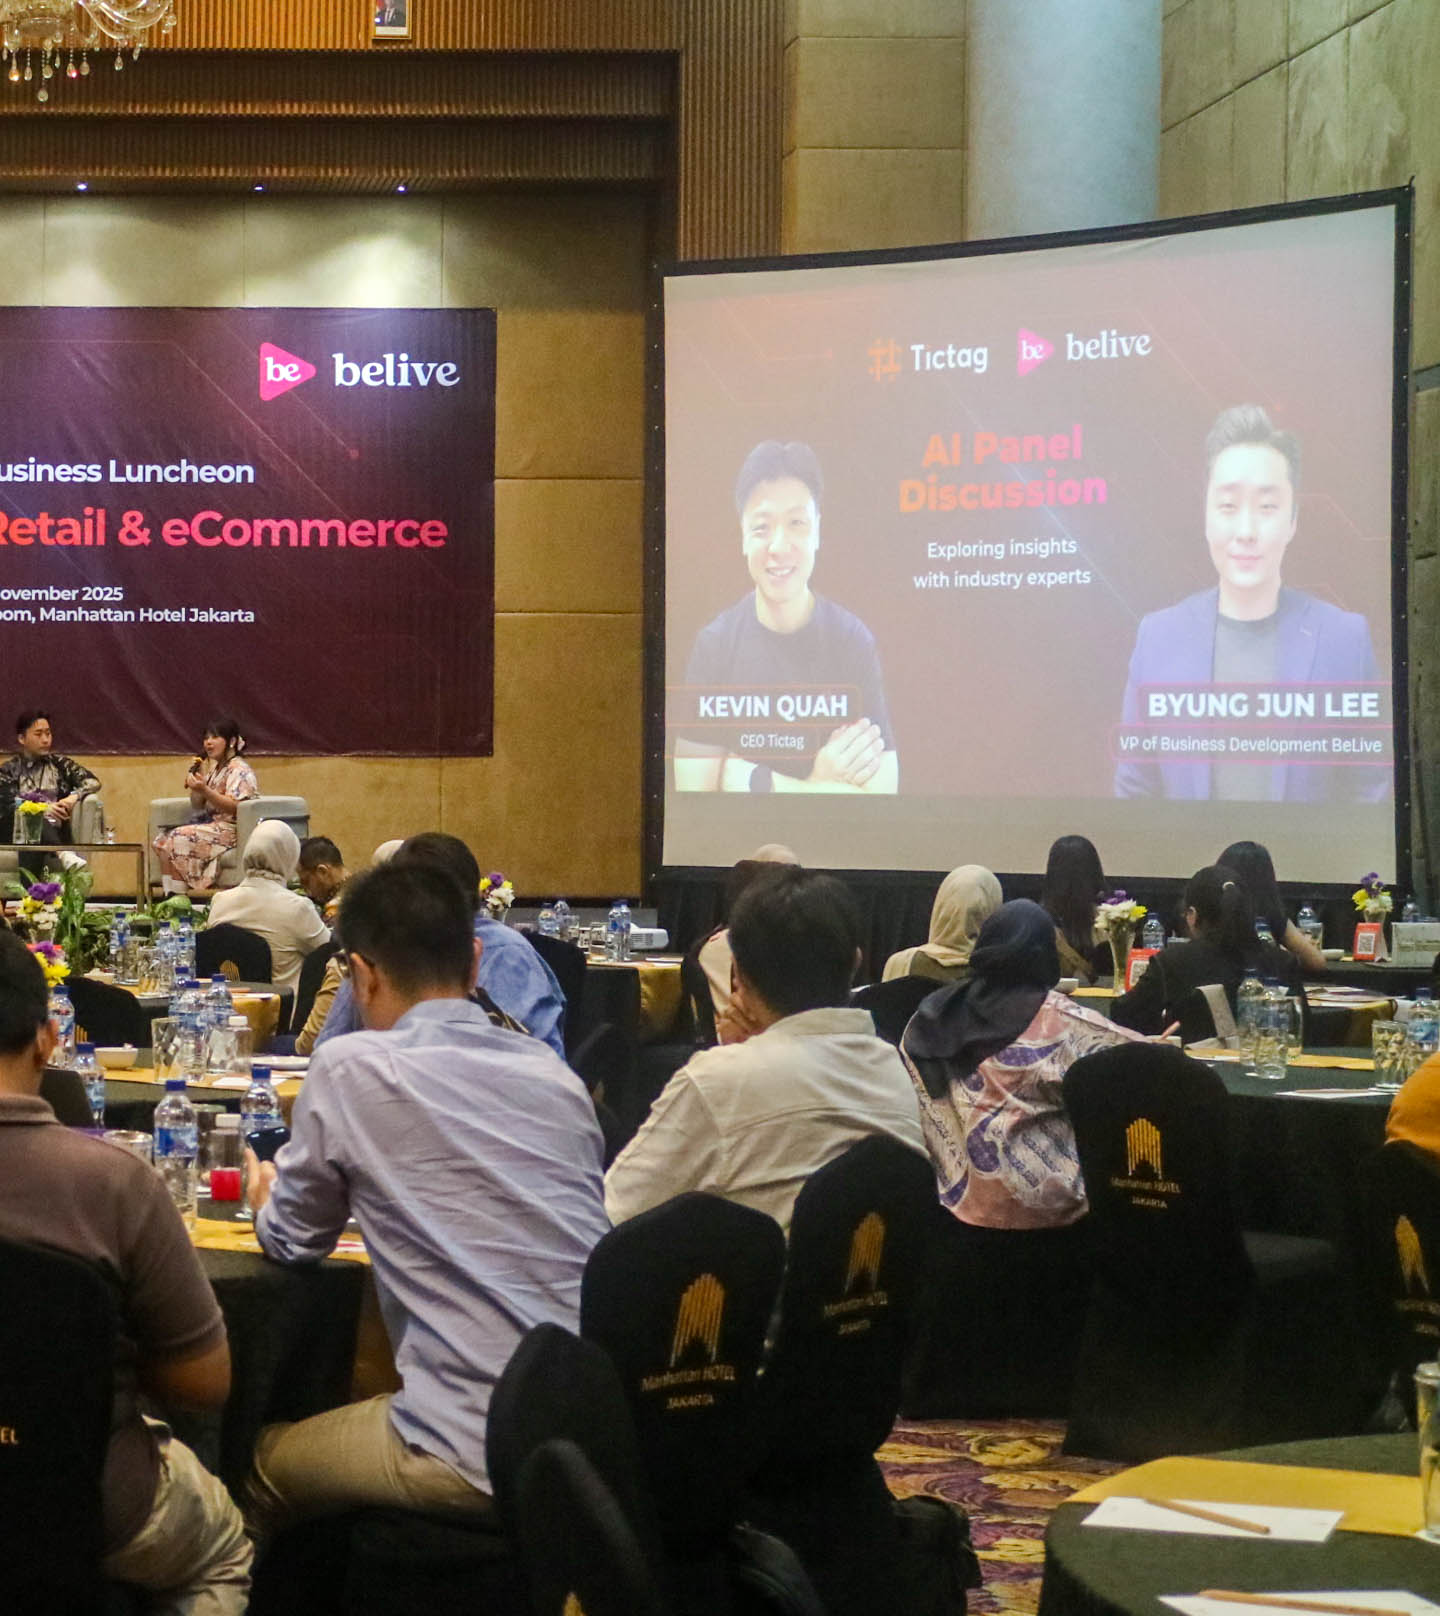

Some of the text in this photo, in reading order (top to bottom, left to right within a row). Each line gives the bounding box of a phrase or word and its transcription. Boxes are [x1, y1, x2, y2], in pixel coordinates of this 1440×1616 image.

[1022, 329, 1152, 361] be belive
[265, 353, 460, 386] be belive
[911, 344, 988, 373] Tictag
[921, 424, 1082, 467] AI Panel
[109, 459, 254, 483] Luncheon
[899, 468, 1107, 512] Discussion
[118, 510, 151, 546] &
[162, 510, 448, 547] eCommerce
[927, 538, 1078, 560] Exploring insights
[913, 568, 1091, 590] with industry experts
[82, 587, 124, 601] 2025
[40, 606, 135, 622] Manhattan
[139, 607, 185, 622] Hotel
[189, 607, 255, 622] Jakarta
[699, 695, 848, 722] KEVIN QUAH
[1148, 693, 1380, 718] BYUNG JUN LEE
[740, 733, 805, 750] CEO Tictag
[1120, 736, 1382, 754] VP of Business Development BeLive
